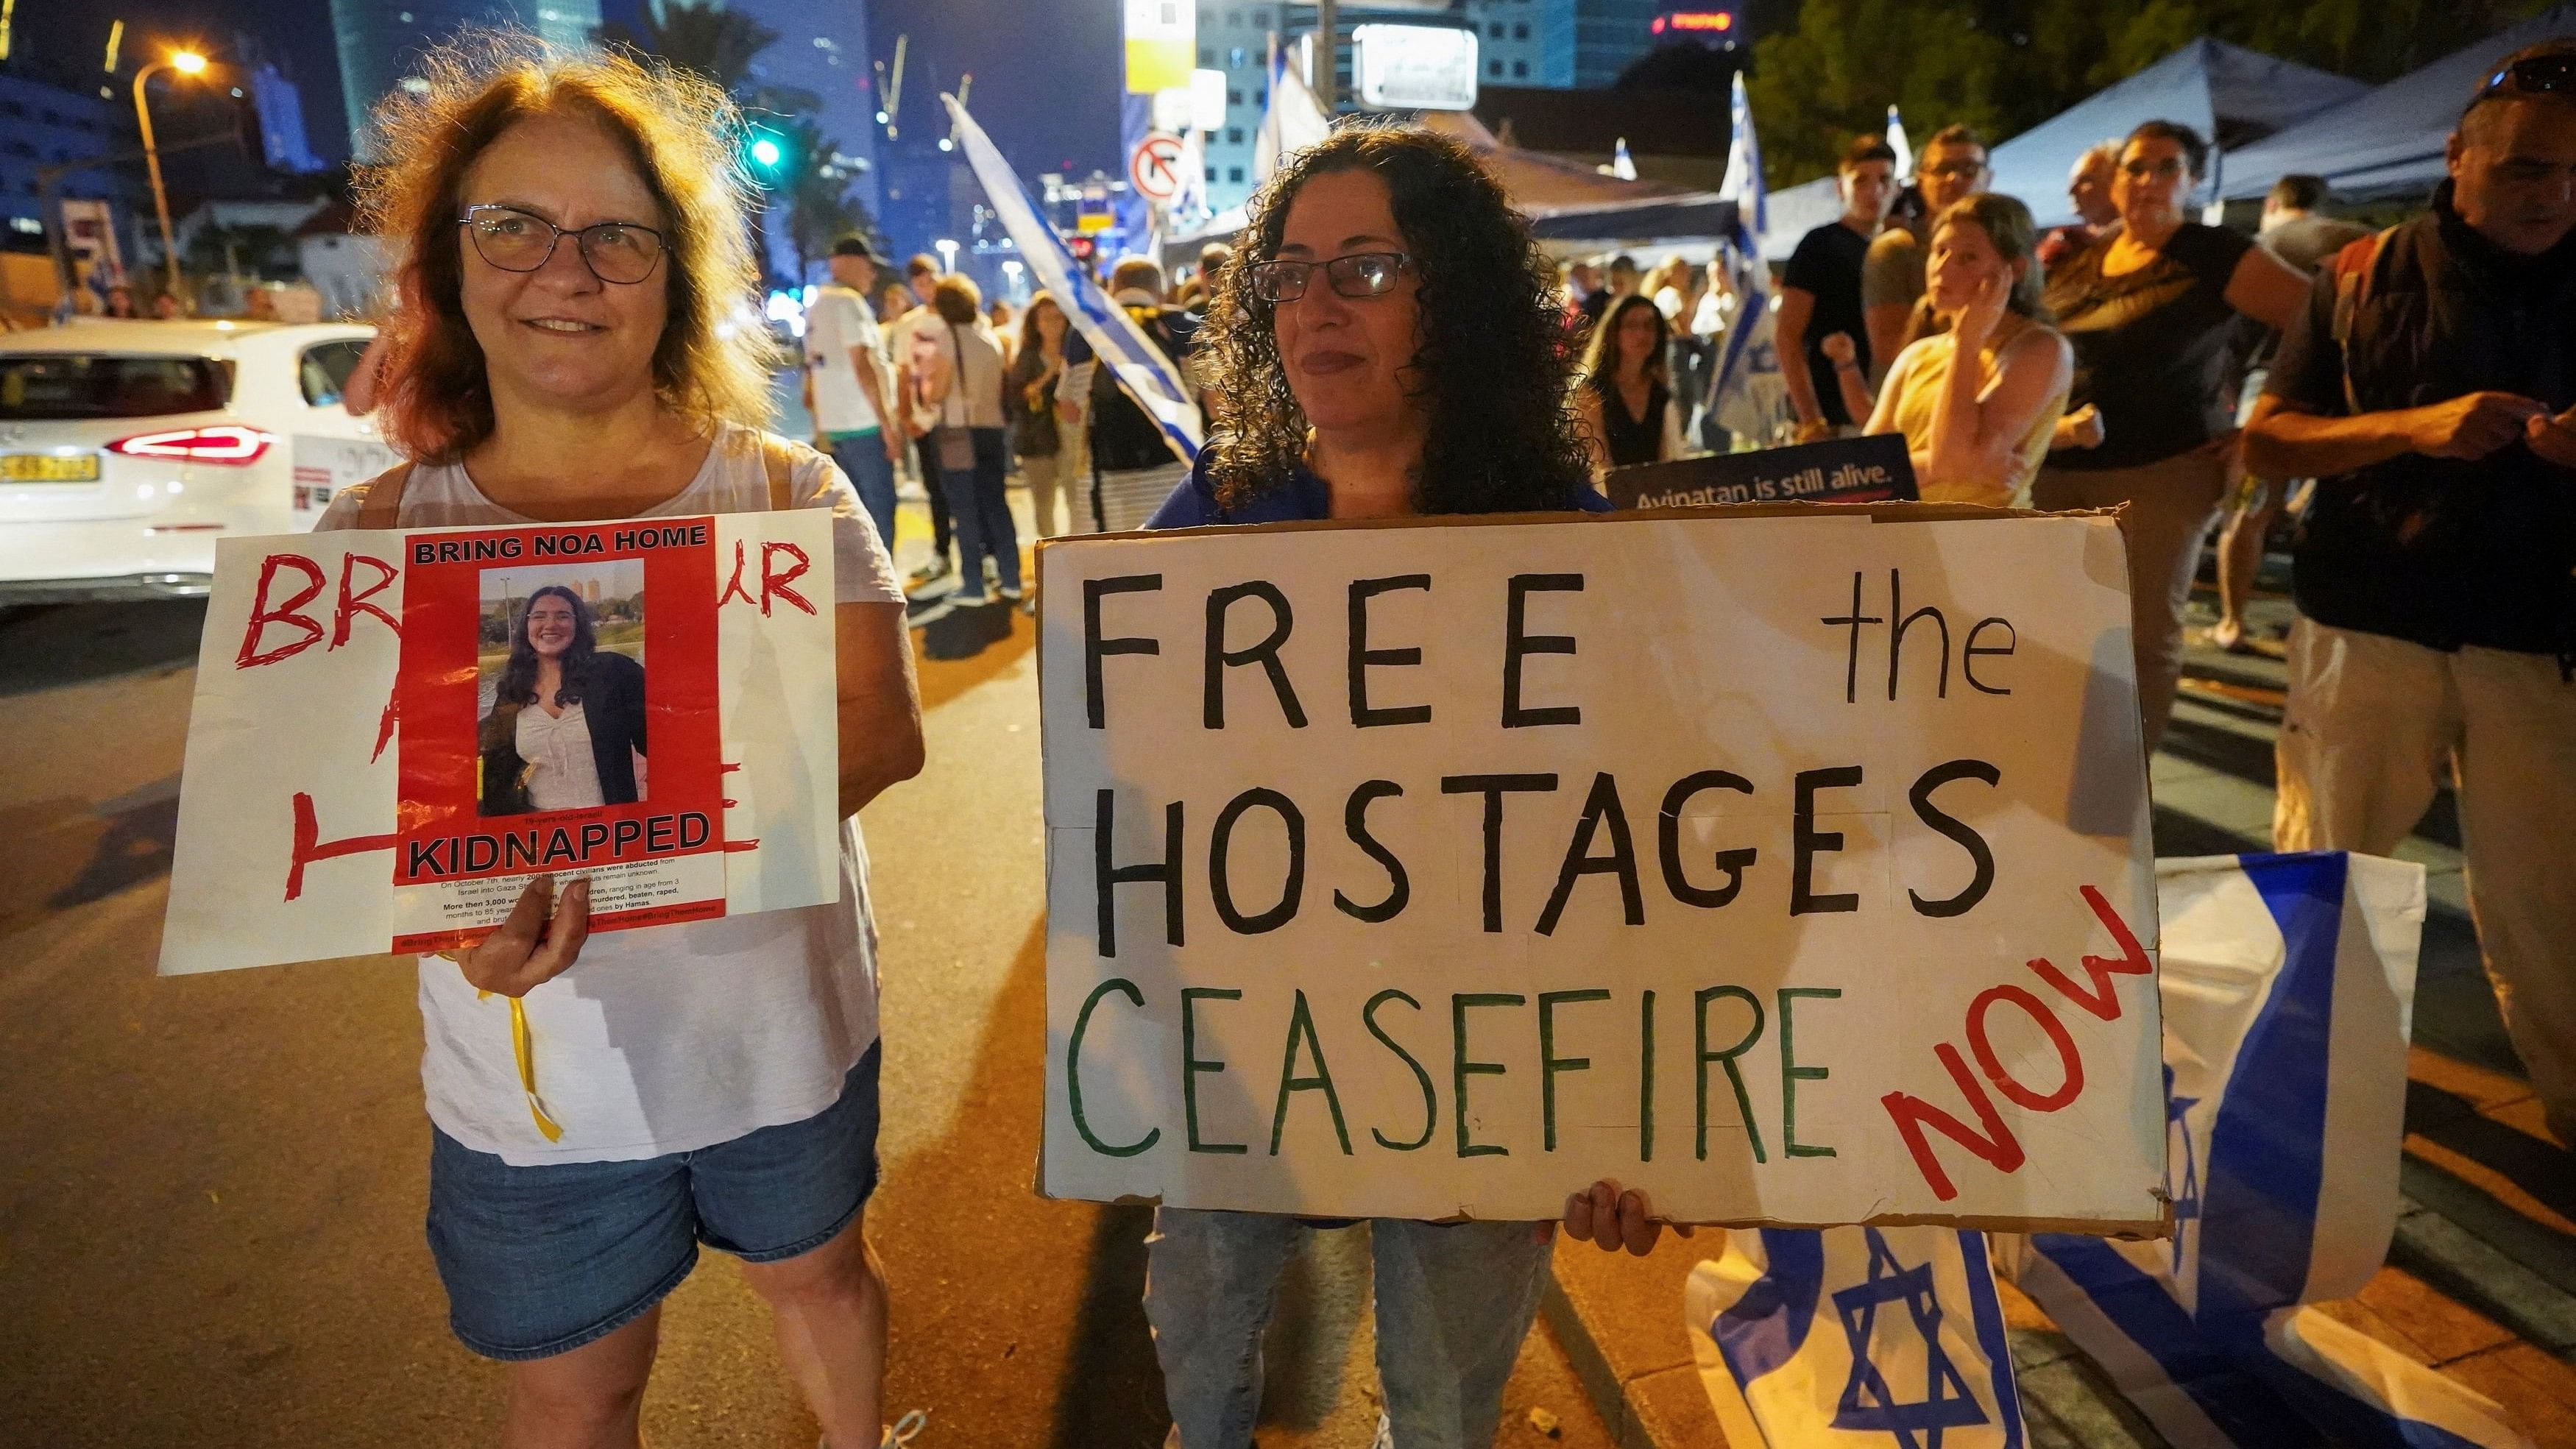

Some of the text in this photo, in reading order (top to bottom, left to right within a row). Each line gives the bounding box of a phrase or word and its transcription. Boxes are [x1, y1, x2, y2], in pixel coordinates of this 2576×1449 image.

[1754, 475, 1777, 499] is
[1780, 467, 1825, 496] still
[1830, 463, 1892, 489] alive.
[414, 524, 707, 565] BRING NOA HOME
[1083, 567, 2017, 730] FREE the
[408, 811, 711, 879] KIDNAPPED
[1094, 758, 2003, 958] HOSTAGES
[453, 879, 484, 888] October
[576, 866, 604, 875] civilians
[625, 860, 658, 869] abducted
[643, 882, 657, 890] age
[445, 911, 473, 920] months
[590, 893, 627, 904] murdered,
[629, 890, 654, 899] beaten,
[656, 887, 679, 896] raped,
[1879, 884, 2154, 1201] NOW
[1066, 976, 1844, 1164] CEASEFIRE
